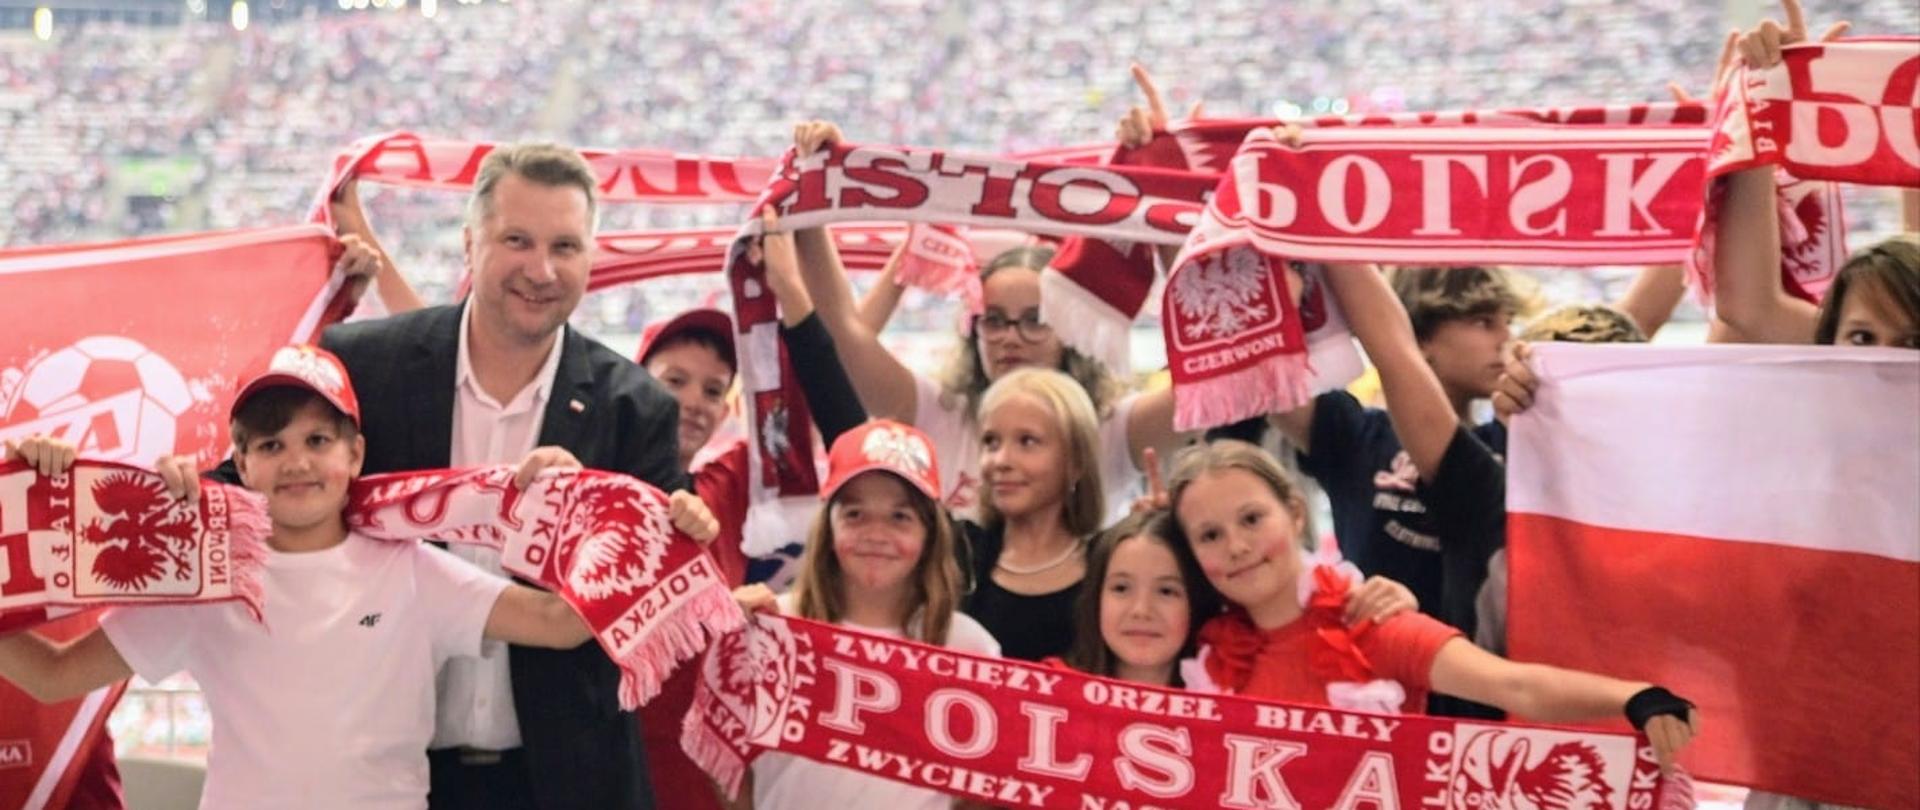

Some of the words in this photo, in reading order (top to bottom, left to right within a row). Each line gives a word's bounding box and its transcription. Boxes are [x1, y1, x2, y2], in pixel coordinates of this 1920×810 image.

[1183, 332, 1285, 374] CZERWONI
[782, 631, 817, 742] TYLKO
[1083, 681, 1222, 722] ORZEŁ
[1255, 704, 1400, 742] BIAŁY
[817, 656, 1402, 810] POLSKA
